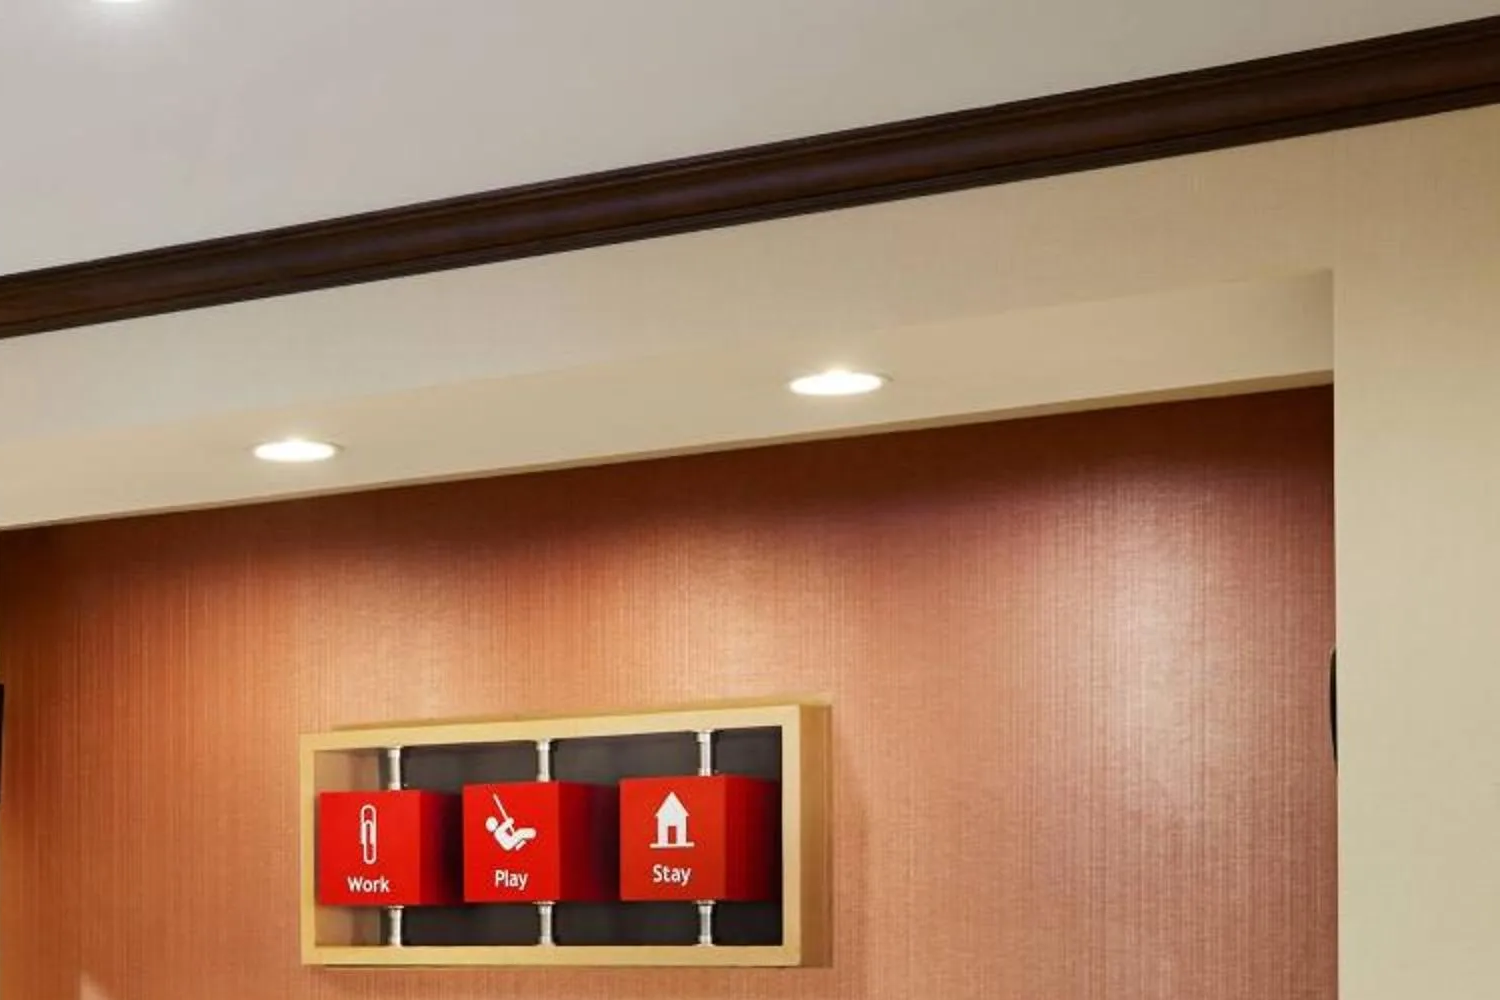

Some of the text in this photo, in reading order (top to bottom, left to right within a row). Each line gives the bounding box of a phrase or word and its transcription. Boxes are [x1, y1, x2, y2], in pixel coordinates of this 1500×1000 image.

[347, 875, 390, 894] Work
[494, 868, 529, 891] Play
[652, 863, 691, 887] Stay
